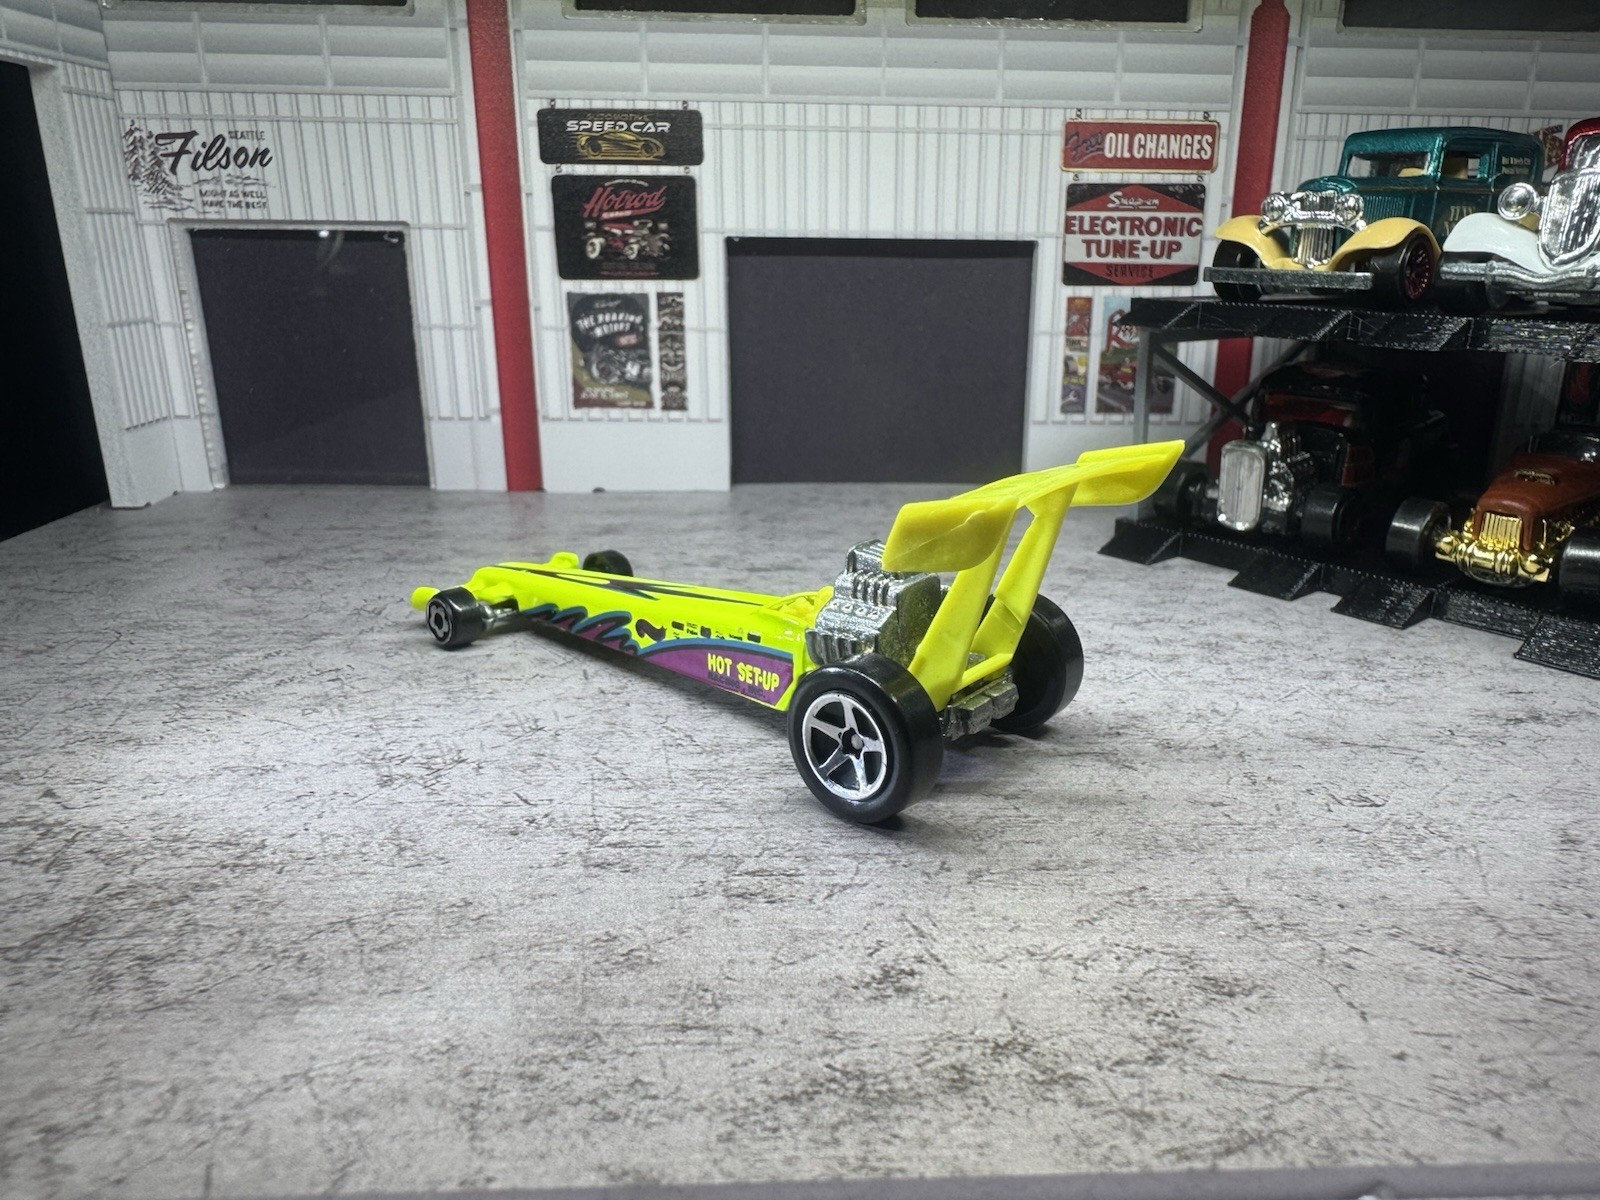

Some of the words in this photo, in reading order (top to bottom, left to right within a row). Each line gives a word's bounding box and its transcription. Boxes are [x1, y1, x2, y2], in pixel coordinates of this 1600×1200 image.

[566, 120, 628, 132] SPEED
[630, 121, 672, 133] CAR
[228, 131, 266, 141] SEATTLE
[155, 130, 273, 176] Filson
[1103, 132, 1131, 158] OIL
[1133, 132, 1214, 160] CHANGES
[229, 190, 240, 198] AS
[241, 190, 267, 198] WELL
[583, 186, 667, 218] Hotrod
[202, 200, 226, 208] HAVE
[245, 201, 267, 209] BEST
[1065, 215, 1203, 237] ELECTRONIC
[1081, 239, 1182, 260] TUNE-UP
[1106, 264, 1154, 279] SERVICE
[576, 314, 596, 330] THE
[707, 652, 733, 677] HOT
[736, 661, 780, 693] SET-UP
